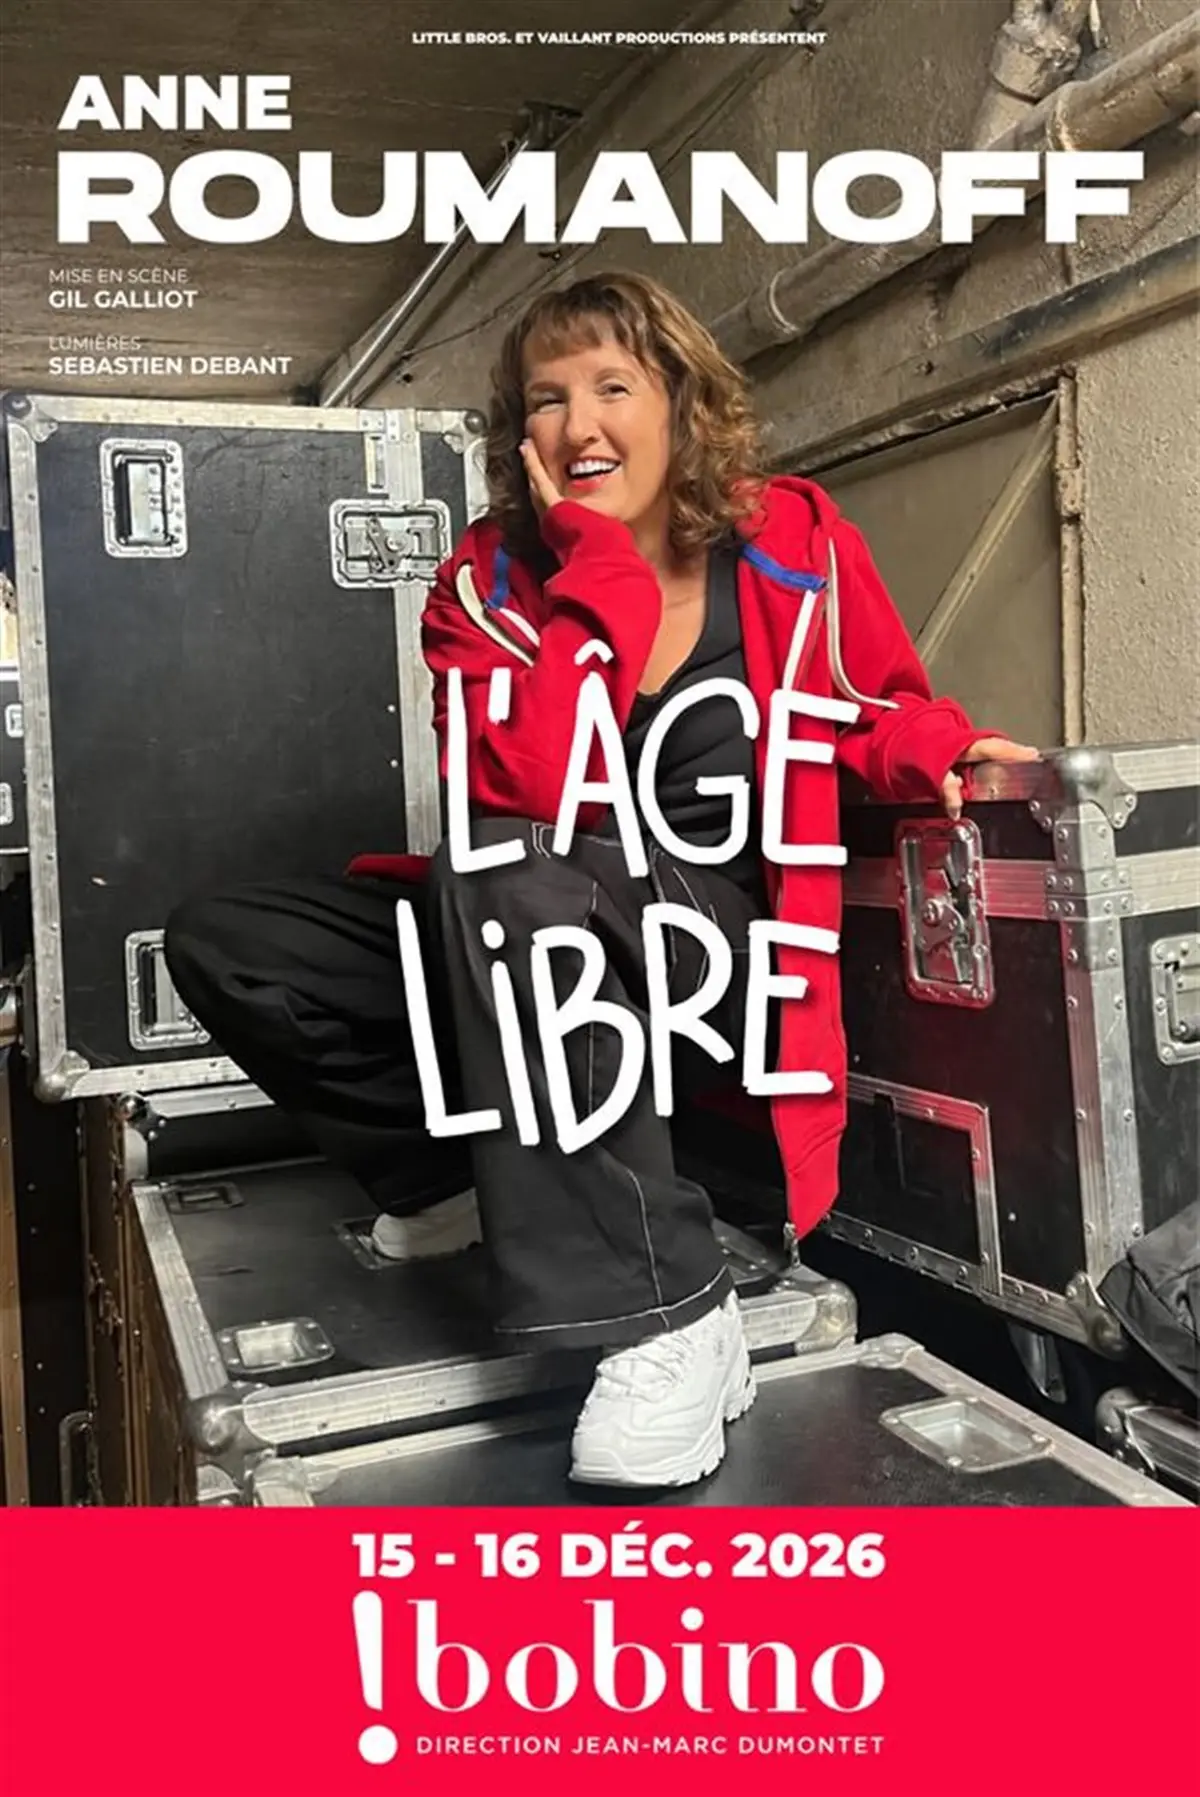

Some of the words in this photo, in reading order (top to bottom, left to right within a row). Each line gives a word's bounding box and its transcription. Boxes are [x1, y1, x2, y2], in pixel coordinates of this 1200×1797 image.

[412, 32, 461, 44] LITTLE
[465, 32, 512, 44] BROS.
[515, 32, 534, 44] ET
[537, 32, 612, 44] VAILLANT
[615, 32, 725, 44] PRODUCTIONS
[729, 30, 827, 44] PRÉSENTENT
[57, 75, 292, 130] ANNE
[57, 149, 1145, 244] ROUMANOFF
[49, 269, 92, 283] MISE
[97, 269, 122, 283] EN
[49, 290, 87, 309] GIL
[94, 290, 198, 309] GALLIOT
[49, 333, 141, 351] LUMIÈRES
[49, 356, 182, 375] SEBASTIEN
[190, 356, 292, 375] DEBANT
[447, 640, 861, 878] L'ÂGE
[352, 1533, 414, 1577] 15
[474, 1533, 541, 1577] 16
[560, 1521, 712, 1577] DÉC.
[730, 1532, 886, 1577] 2026
[416, 1736, 561, 1755] DIRECTION
[571, 1736, 727, 1755] JEAN-MARC
[738, 1736, 885, 1755] DUMONTET
